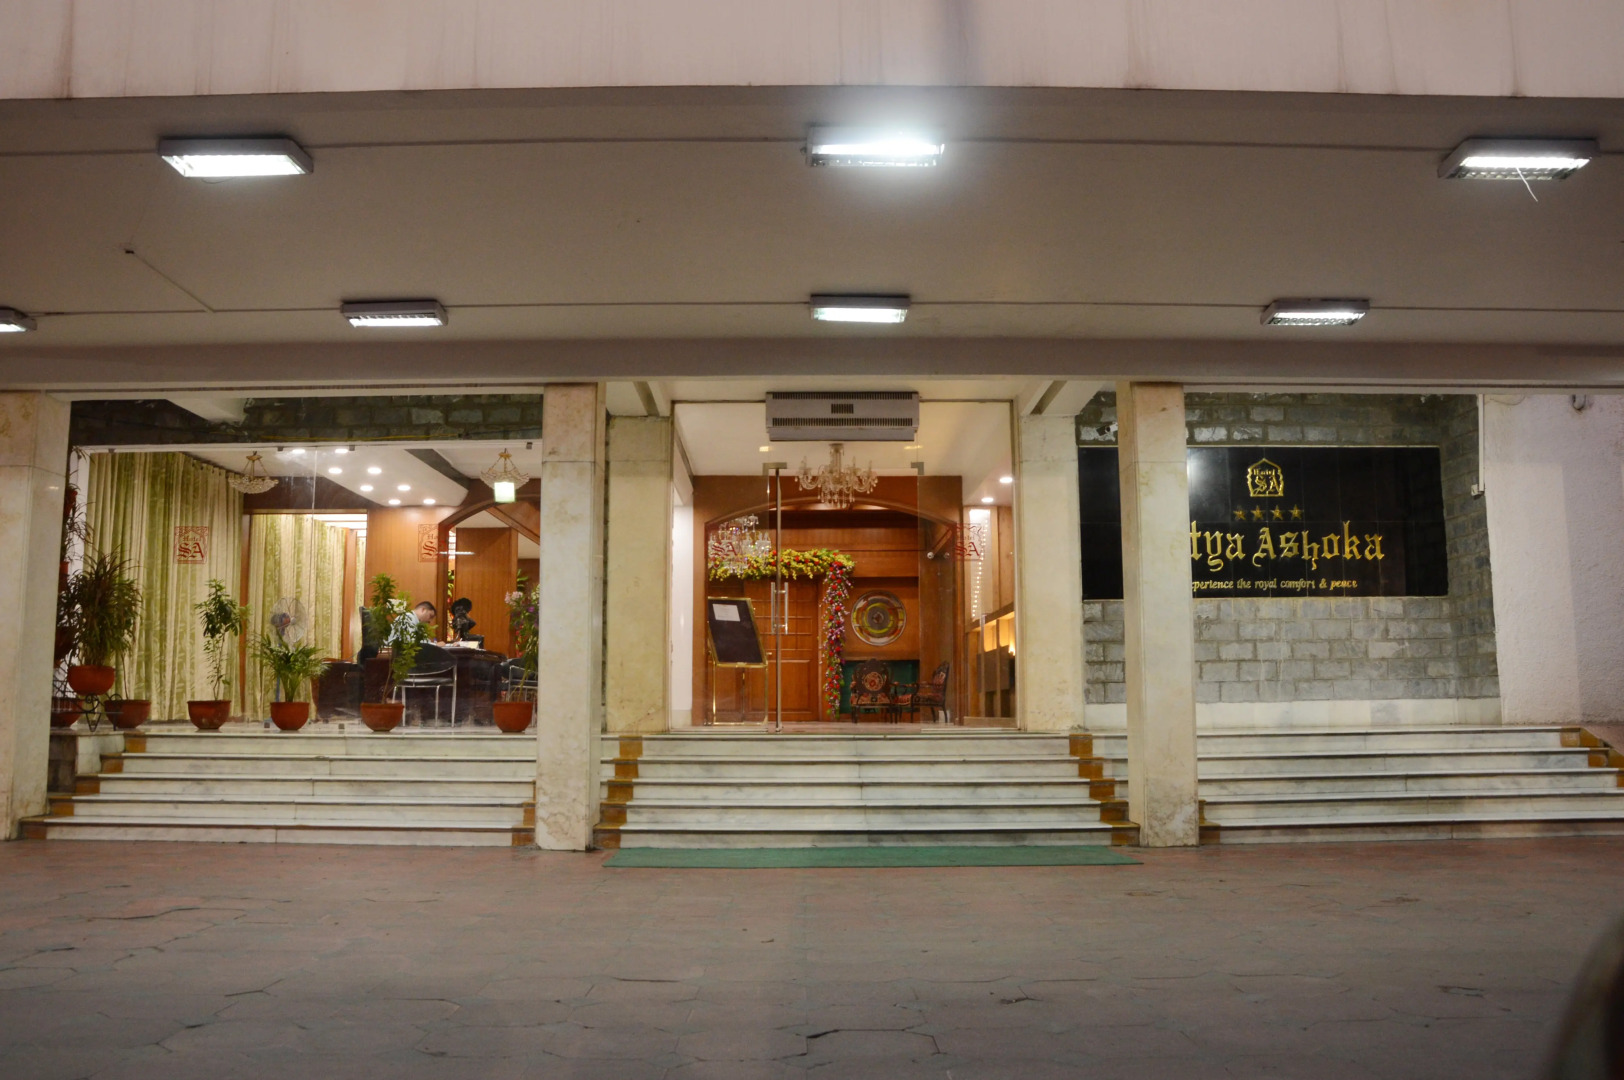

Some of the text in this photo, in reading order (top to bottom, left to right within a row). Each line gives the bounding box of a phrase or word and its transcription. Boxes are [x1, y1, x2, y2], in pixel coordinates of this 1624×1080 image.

[177, 542, 205, 561] SA
[1189, 520, 1385, 573] tya Ashoka
[1191, 577, 1359, 592] perience the royal comfort & peace
